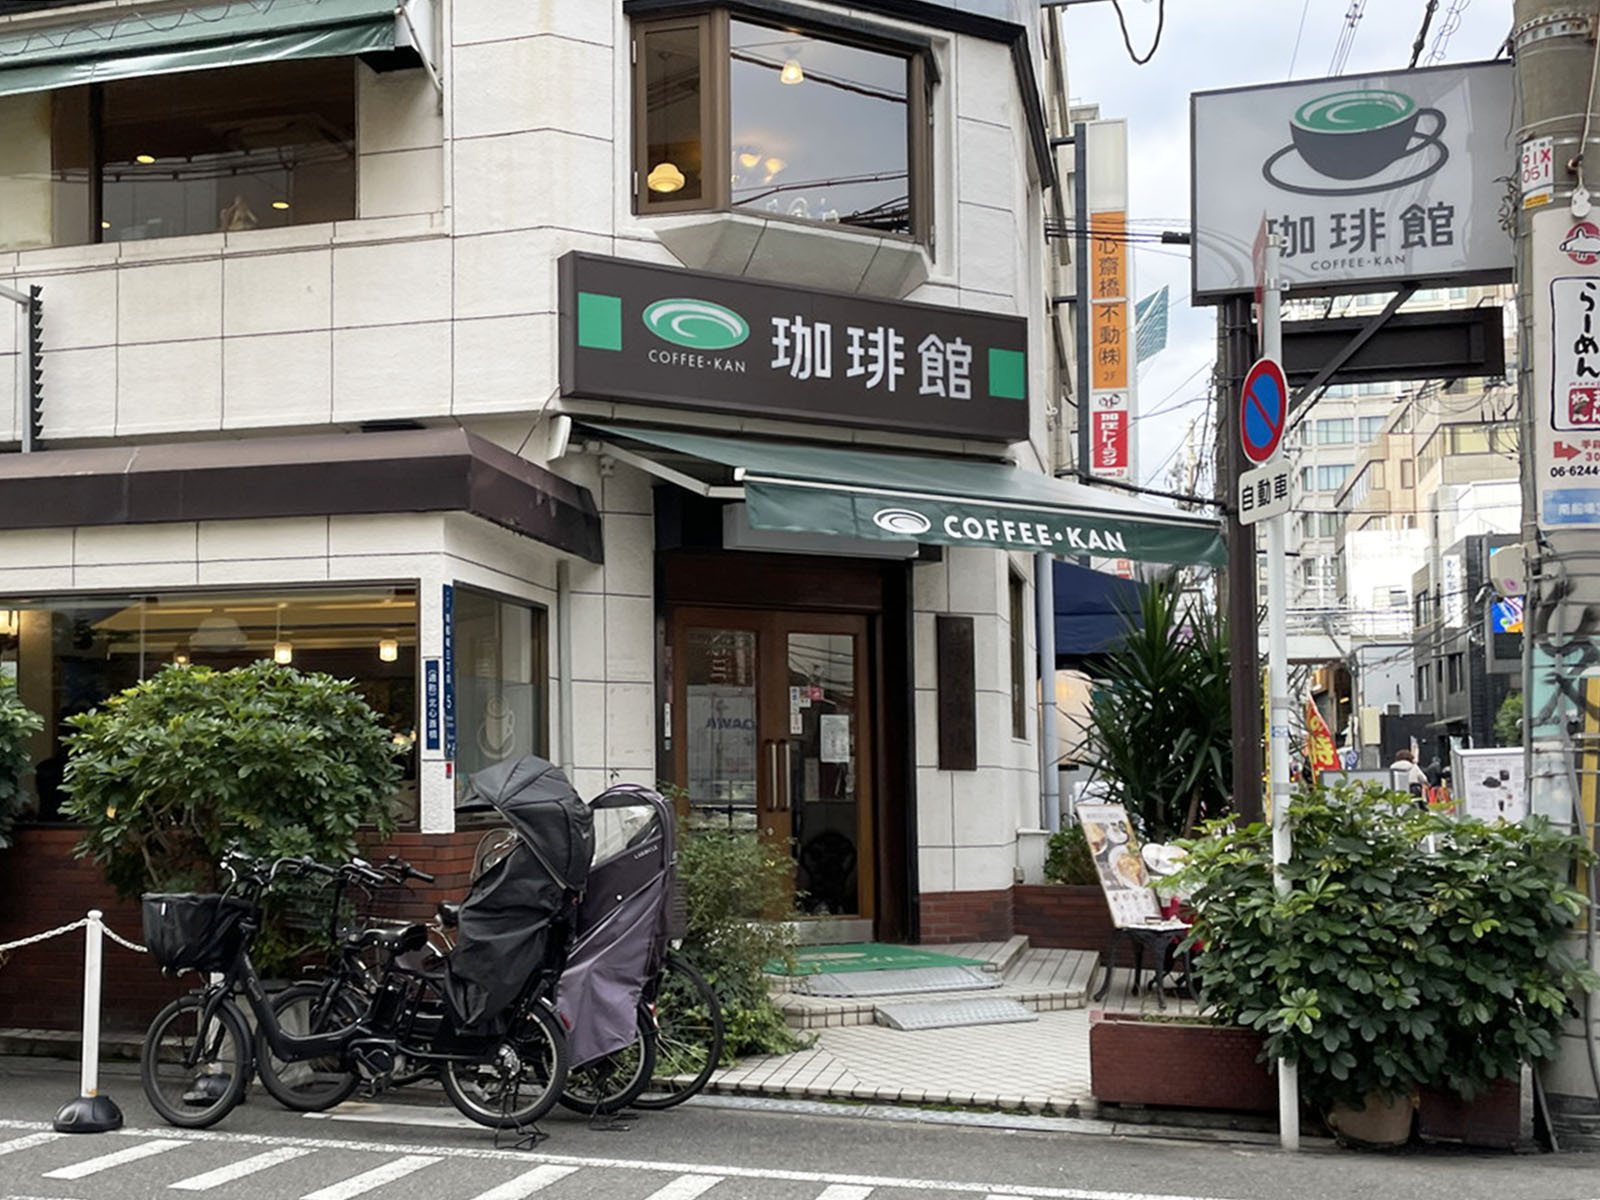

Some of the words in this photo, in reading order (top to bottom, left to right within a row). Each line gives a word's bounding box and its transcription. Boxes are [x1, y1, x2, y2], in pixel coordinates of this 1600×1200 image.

[1267, 201, 1454, 259] 珈琲館
[770, 315, 972, 400] 珈琲館
[1574, 281, 1600, 378] らーめん
[1242, 473, 1288, 511] 自動車
